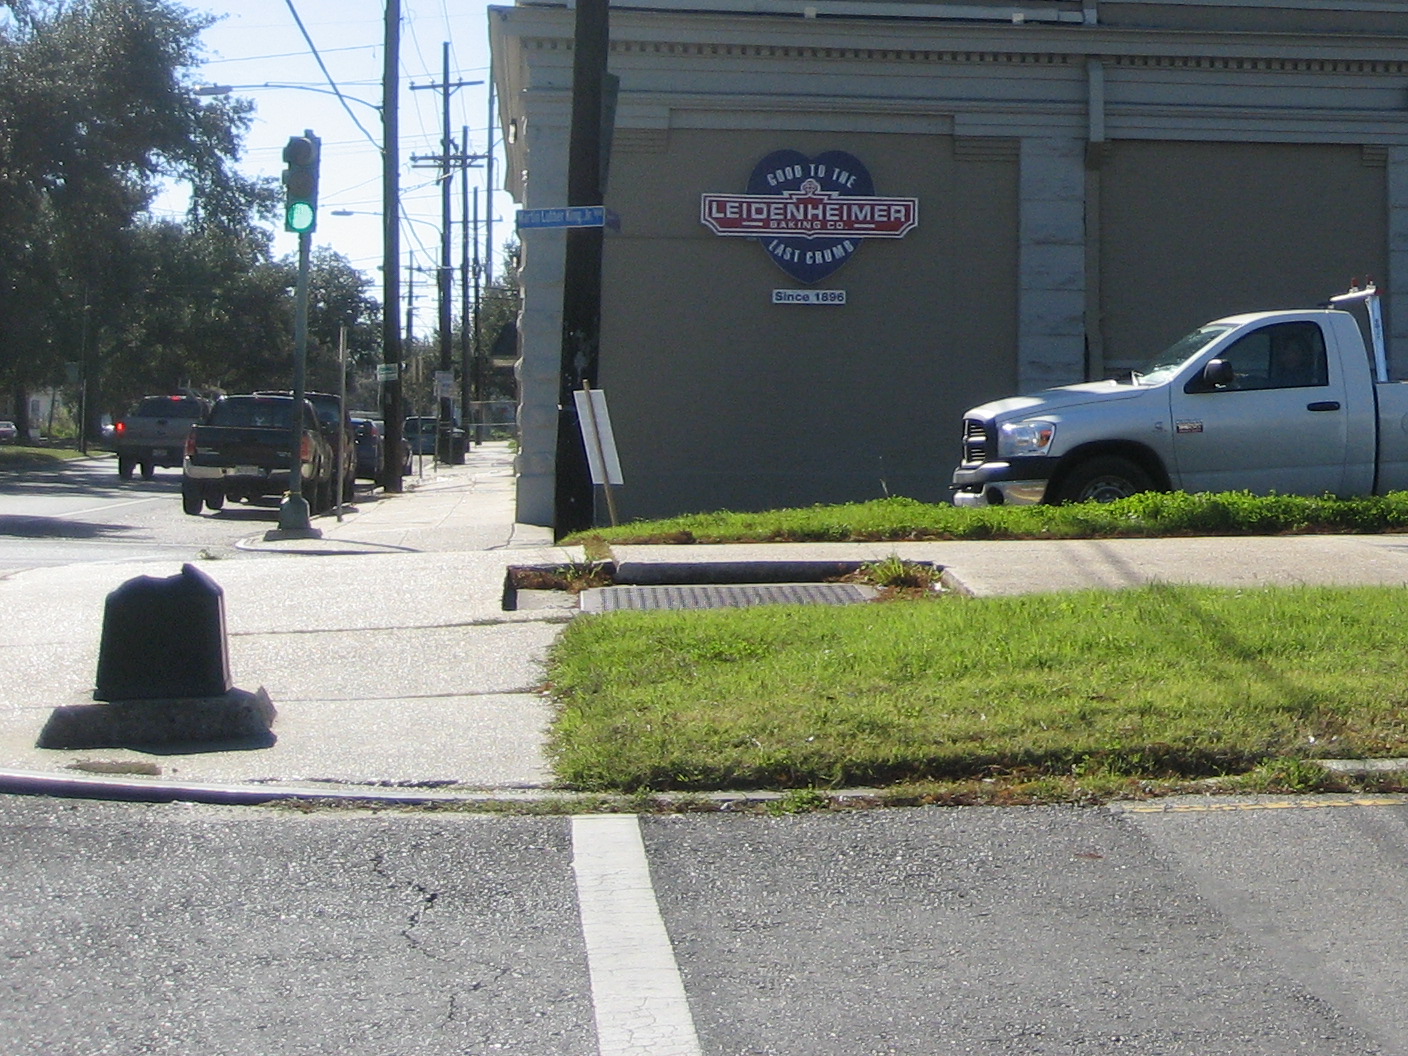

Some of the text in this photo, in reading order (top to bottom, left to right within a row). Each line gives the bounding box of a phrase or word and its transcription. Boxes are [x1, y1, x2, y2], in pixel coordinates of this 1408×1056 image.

[767, 163, 857, 189] GOOD TO THE
[711, 201, 906, 222] LEIDENHEIMER
[769, 221, 848, 230] BAKING CO.
[768, 239, 855, 265] LAST CRUMB
[774, 291, 845, 302] Since 1896
